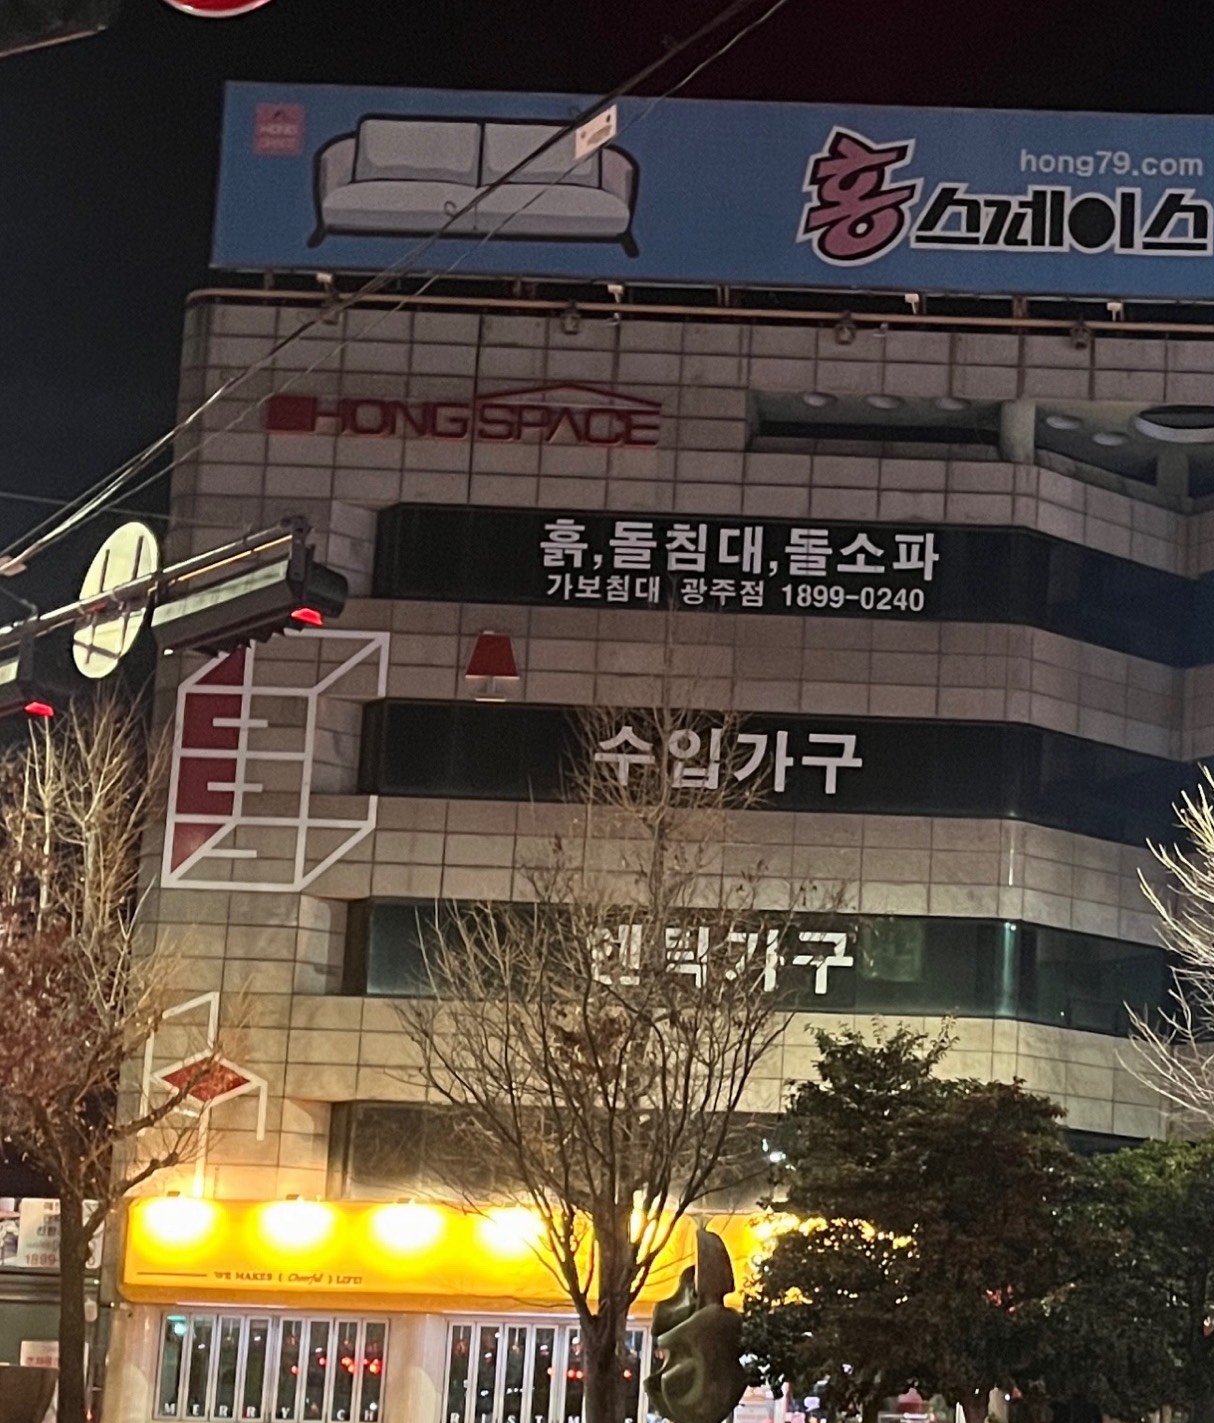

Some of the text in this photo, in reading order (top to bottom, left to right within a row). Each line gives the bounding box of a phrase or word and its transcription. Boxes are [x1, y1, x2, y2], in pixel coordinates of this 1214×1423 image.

[1019, 149, 1204, 177] hong79.com
[546, 574, 925, 612] 가보침대 광주점 1899-0240
[594, 725, 863, 794] 수입가구
